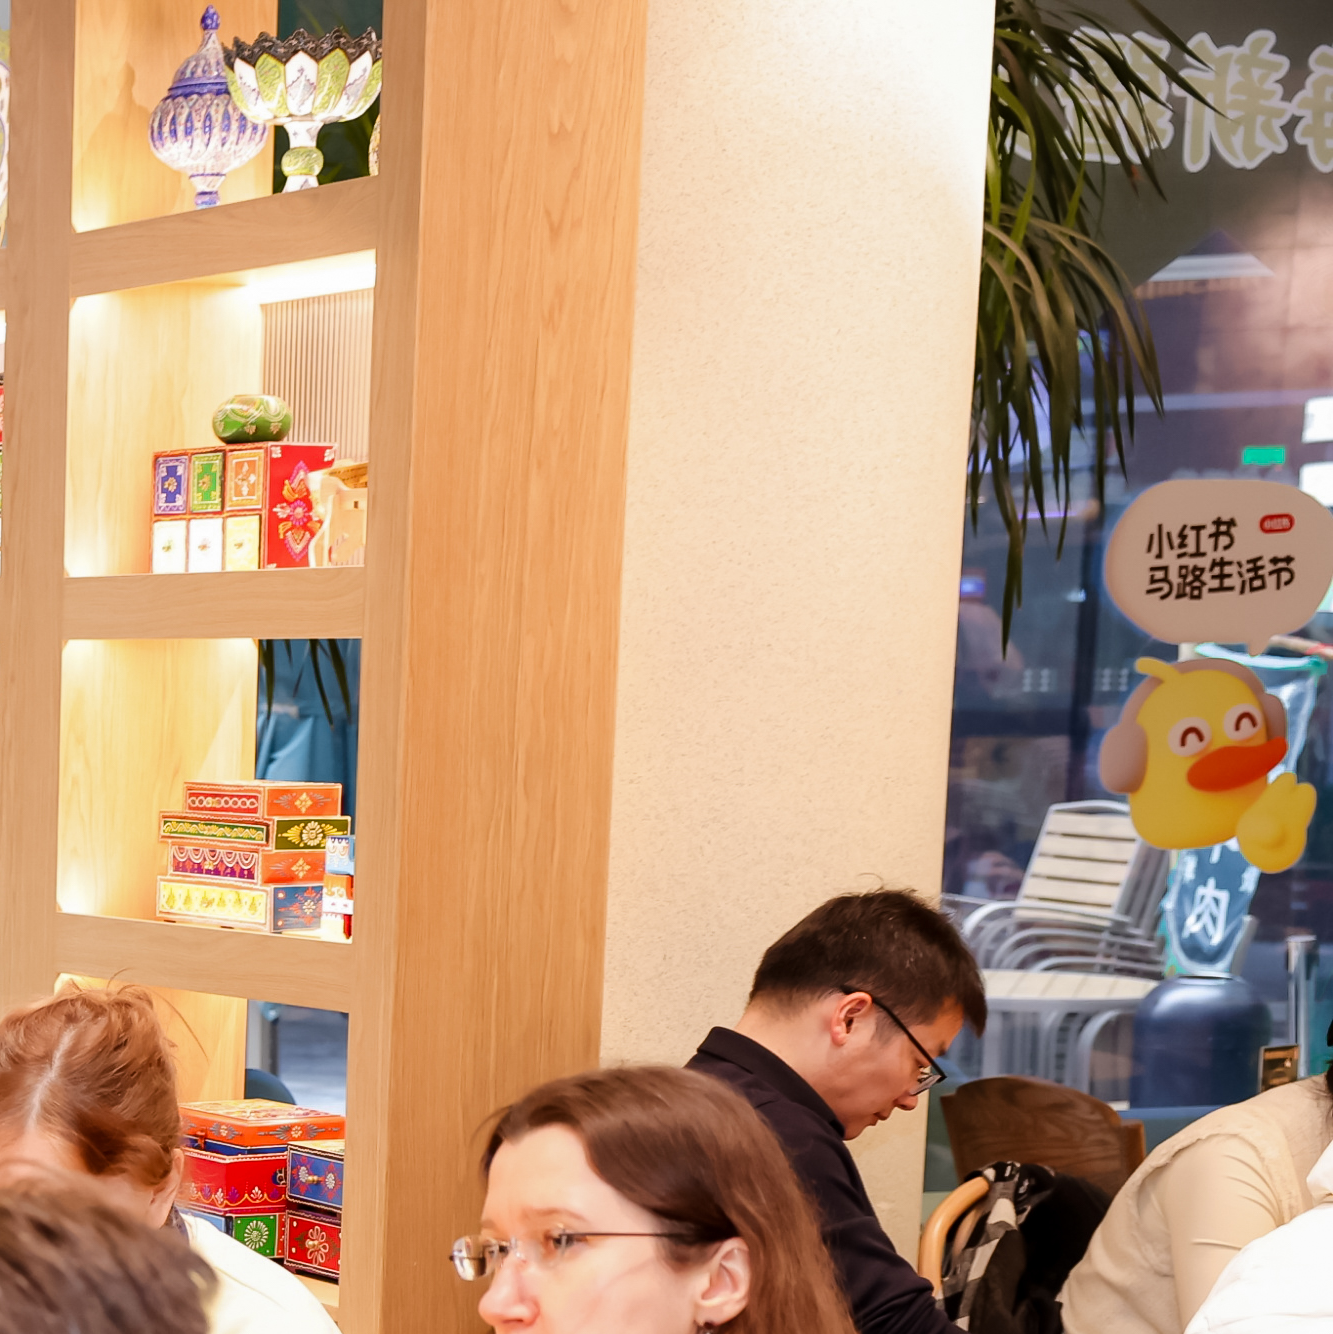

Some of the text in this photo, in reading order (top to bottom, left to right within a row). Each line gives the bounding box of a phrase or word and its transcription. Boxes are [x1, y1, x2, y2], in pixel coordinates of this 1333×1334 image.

[1146, 516, 1237, 559] 小红书
[1145, 555, 1296, 600] 马路生活节
